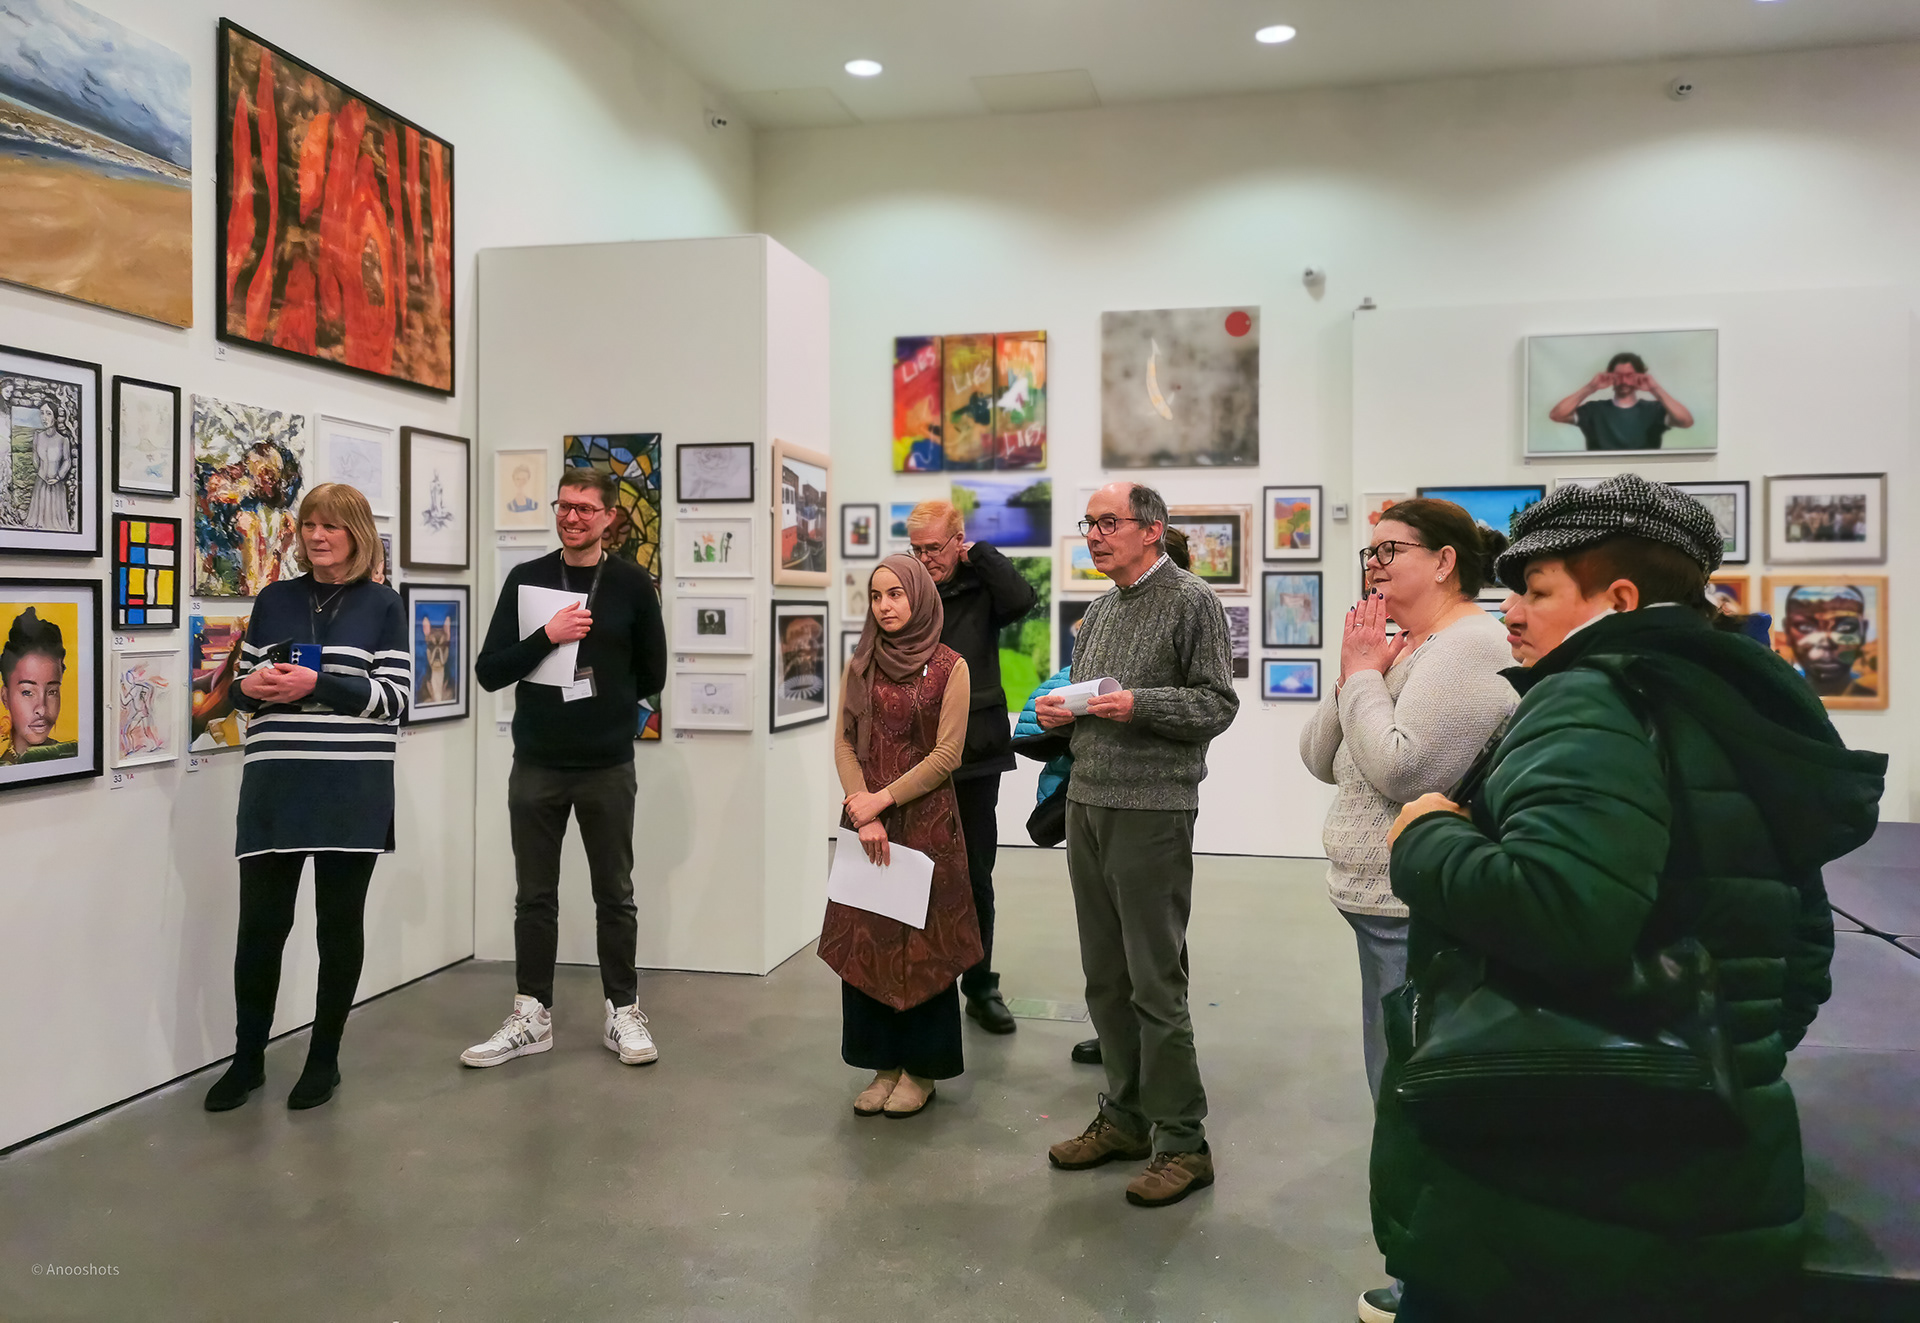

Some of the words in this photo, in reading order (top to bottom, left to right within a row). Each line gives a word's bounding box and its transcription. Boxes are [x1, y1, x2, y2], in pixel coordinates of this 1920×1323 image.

[902, 346, 936, 384] LIES
[952, 359, 992, 395] LIES
[1003, 422, 1042, 456] LIES
[114, 499, 124, 508] 31
[191, 602, 201, 610] 35
[114, 636, 124, 645] 32
[190, 758, 199, 766] 36
[113, 774, 123, 783] 33
